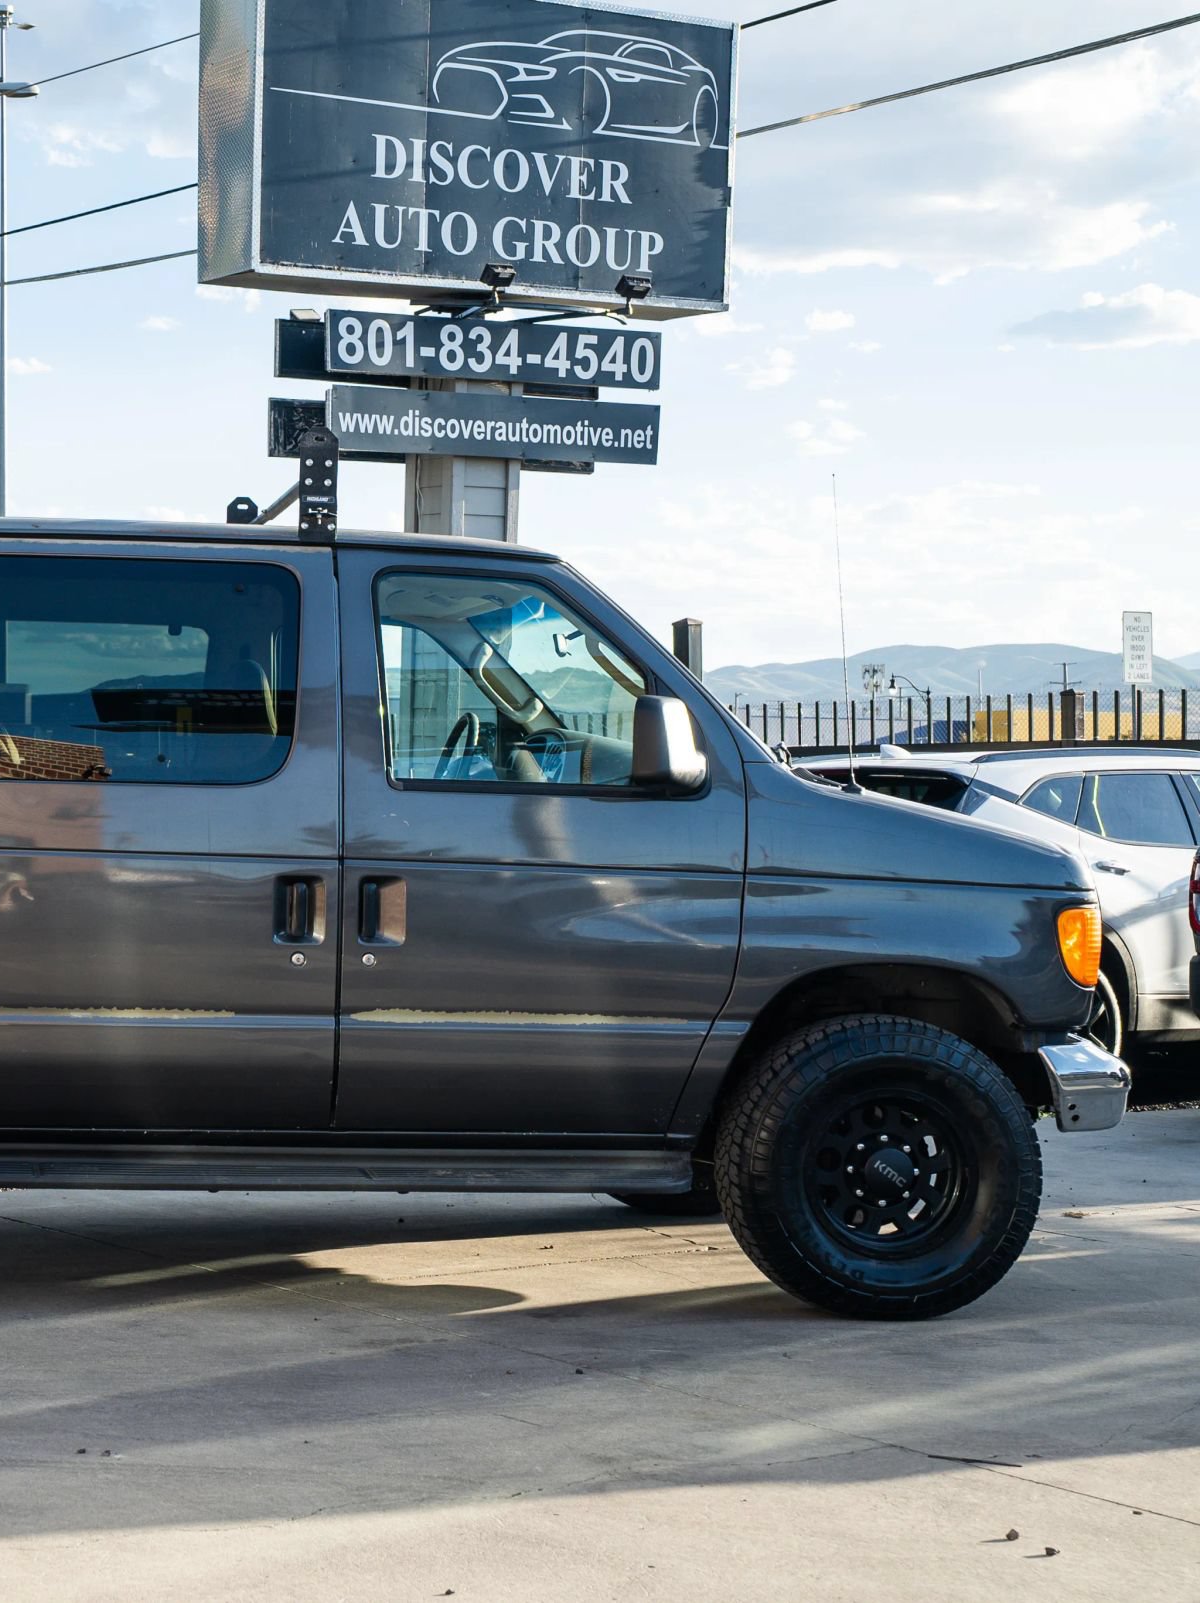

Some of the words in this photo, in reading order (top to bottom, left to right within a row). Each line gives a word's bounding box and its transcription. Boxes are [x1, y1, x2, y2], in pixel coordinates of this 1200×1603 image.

[370, 133, 633, 205] DISCOVER
[332, 200, 478, 256] AUTO
[492, 215, 665, 273] GROUP
[337, 316, 655, 383] 801-834-4540
[338, 409, 653, 450] www.discoverautomotive.net
[873, 1159, 907, 1188] KMC
